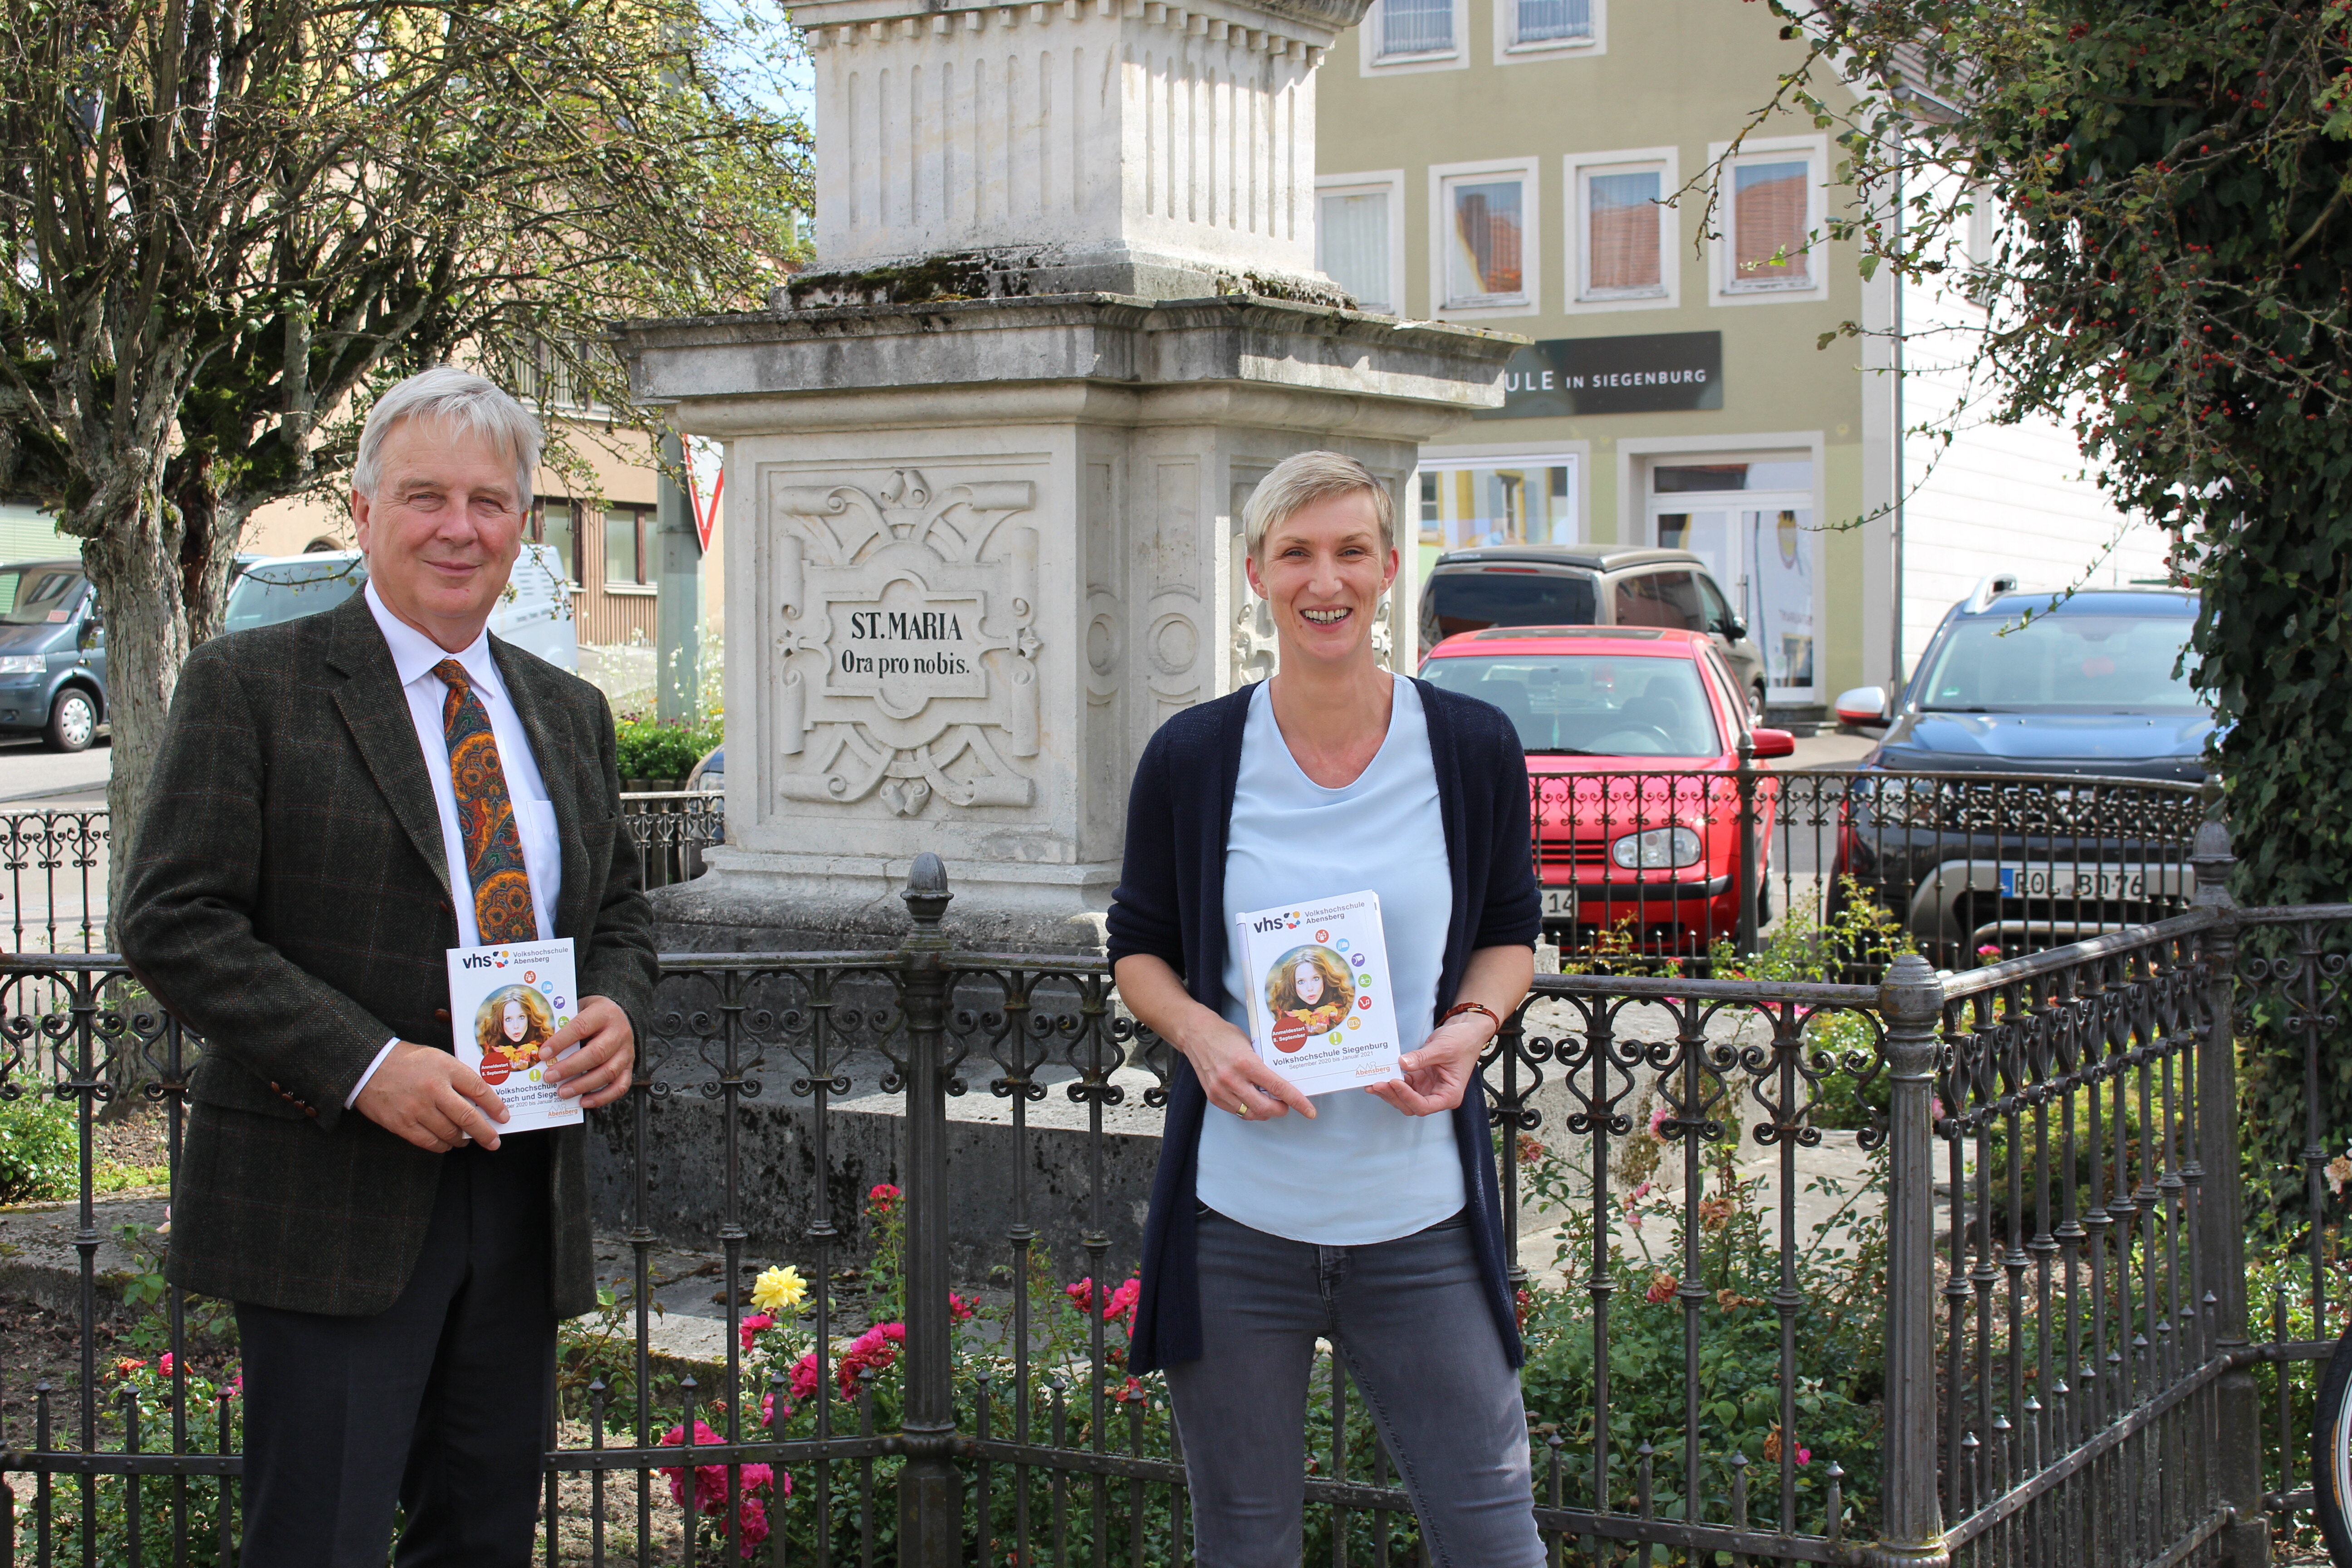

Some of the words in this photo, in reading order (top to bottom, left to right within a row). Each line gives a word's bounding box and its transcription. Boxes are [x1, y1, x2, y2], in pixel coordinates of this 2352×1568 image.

[1505, 371, 1554, 392] ULE
[1566, 376, 1584, 389] IN
[1592, 369, 1707, 387] SIEGENBURG
[852, 612, 885, 639] ST.
[888, 612, 963, 640] MARIA
[842, 649, 874, 673] Ora
[878, 657, 909, 679] pro
[914, 652, 970, 674] nobis.
[1304, 901, 1365, 917] Volkshochschule
[1254, 917, 1283, 933] vhs
[1306, 913, 1345, 925] Abensberg
[513, 946, 568, 958] Volkshochschule
[463, 953, 492, 969] vhs
[514, 956, 550, 965] Abensberg
[1272, 1026, 1305, 1036] Anmeldestart
[1279, 1033, 1306, 1042] September
[1273, 1049, 1340, 1066] Volkshochschule
[1342, 1041, 1388, 1054] Siegenburg
[1289, 1060, 1317, 1070] September
[1355, 1066, 1390, 1076] Abensberg
[495, 1083, 558, 1095] Volkshochschule
[502, 1095, 519, 1103] bach
[548, 1108, 578, 1117] Abensberg
